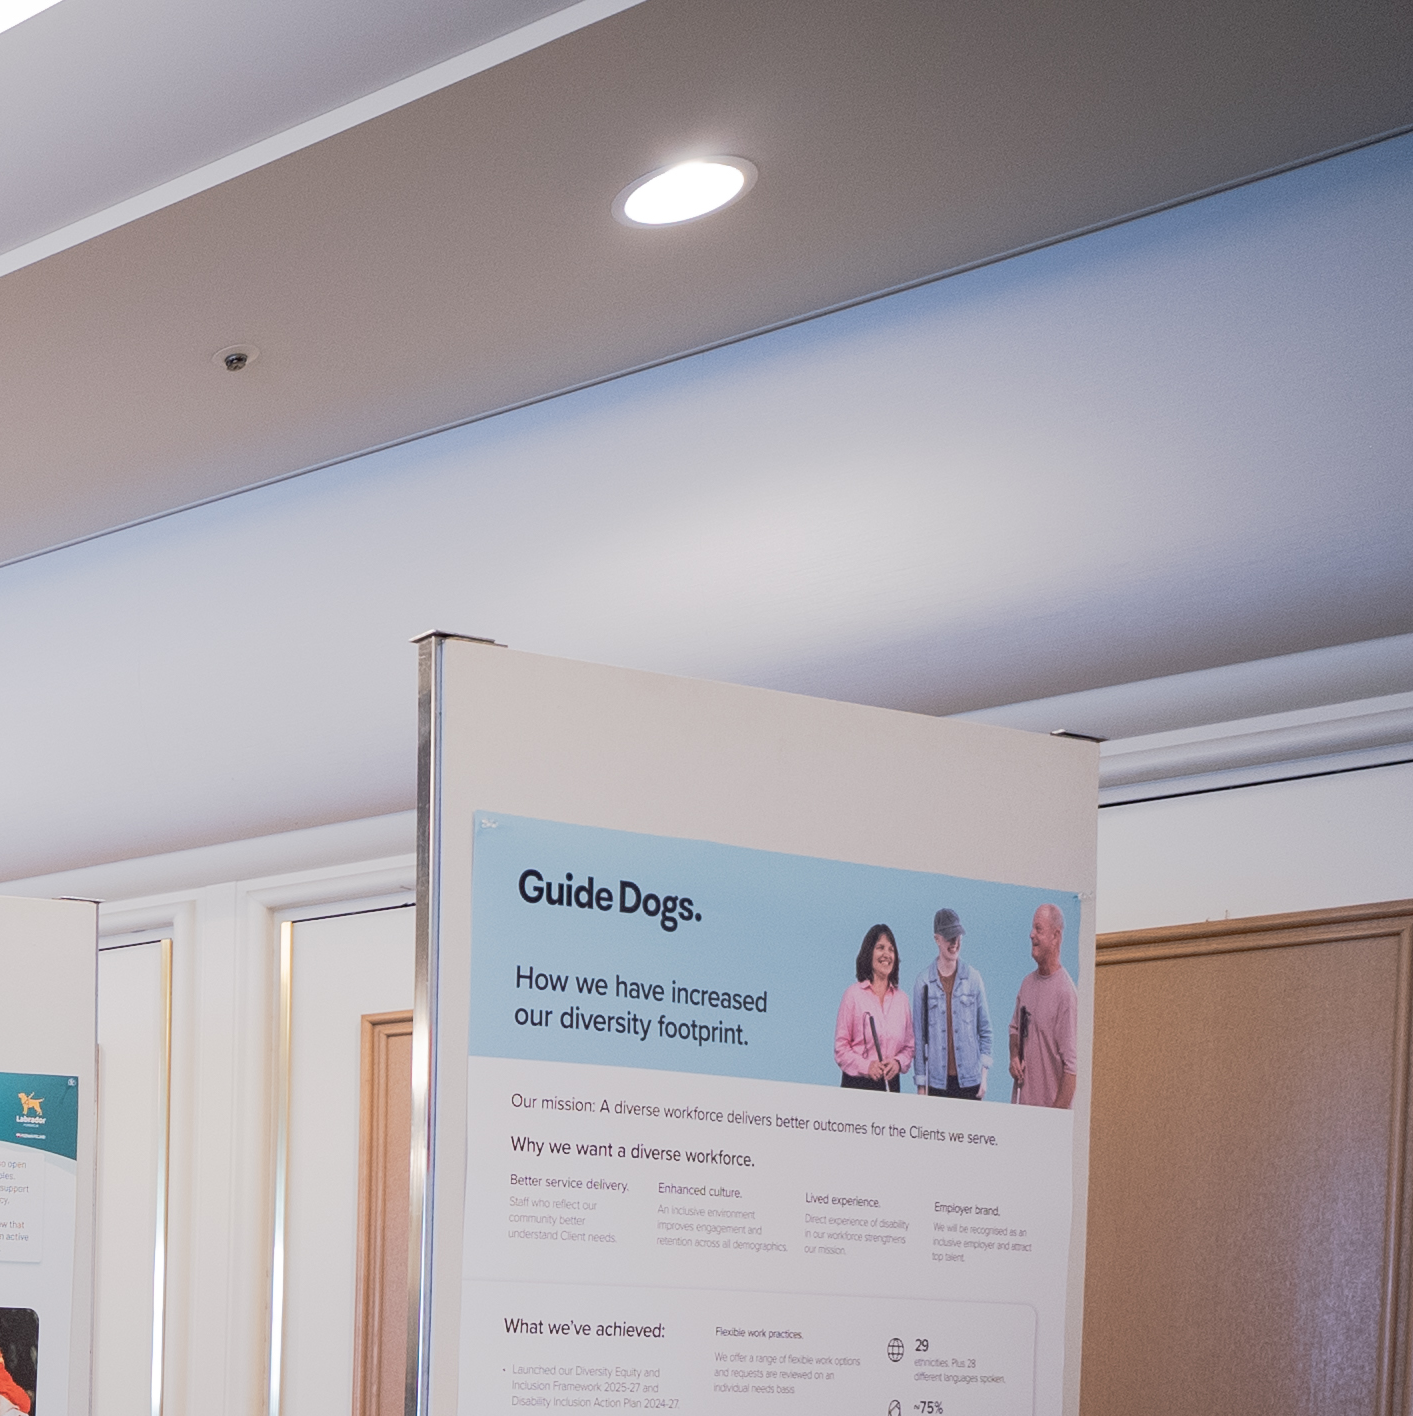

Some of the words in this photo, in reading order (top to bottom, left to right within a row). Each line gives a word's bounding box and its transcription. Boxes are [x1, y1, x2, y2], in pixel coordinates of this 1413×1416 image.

[518, 869, 613, 912] Guide
[619, 880, 702, 930] Dogs.
[516, 965, 569, 992] How
[575, 976, 608, 996] we
[616, 974, 665, 1002] have
[672, 980, 767, 1013] increased
[514, 1007, 553, 1027] our
[560, 1006, 652, 1042] diversity
[657, 1014, 748, 1047] footprint.
[511, 1093, 537, 1109] Our
[541, 1096, 595, 1113] mission:
[599, 1099, 610, 1113] A
[614, 1100, 660, 1117] diverse
[663, 1106, 724, 1123] workforce
[727, 1110, 772, 1127] delivers
[776, 1114, 810, 1130] better
[813, 1119, 868, 1135] outcomes
[871, 1122, 886, 1136] for
[888, 1124, 906, 1138] the
[909, 1125, 946, 1142] Clients
[948, 1132, 965, 1143] we
[967, 1133, 998, 1146] serve.
[510, 1136, 545, 1157] Why
[548, 1142, 571, 1155] we
[576, 1143, 613, 1158] want
[617, 1146, 626, 1158] a
[630, 1143, 681, 1162] diverse
[685, 1149, 755, 1167] workforce.
[510, 1173, 542, 1187] Better
[545, 1178, 583, 1189] service
[586, 1178, 628, 1194] delivery.
[658, 1182, 706, 1196] Enhanced
[708, 1187, 742, 1199] culture.
[805, 1192, 829, 1205] Lived
[934, 1201, 973, 1216] Employer
[975, 1206, 1001, 1217] brand.
[504, 1317, 544, 1335] What
[548, 1320, 591, 1336] we've
[596, 1321, 665, 1338] achieved:
[715, 1326, 746, 1338] Flexible
[748, 1329, 766, 1338] work
[915, 1338, 929, 1352] 29
